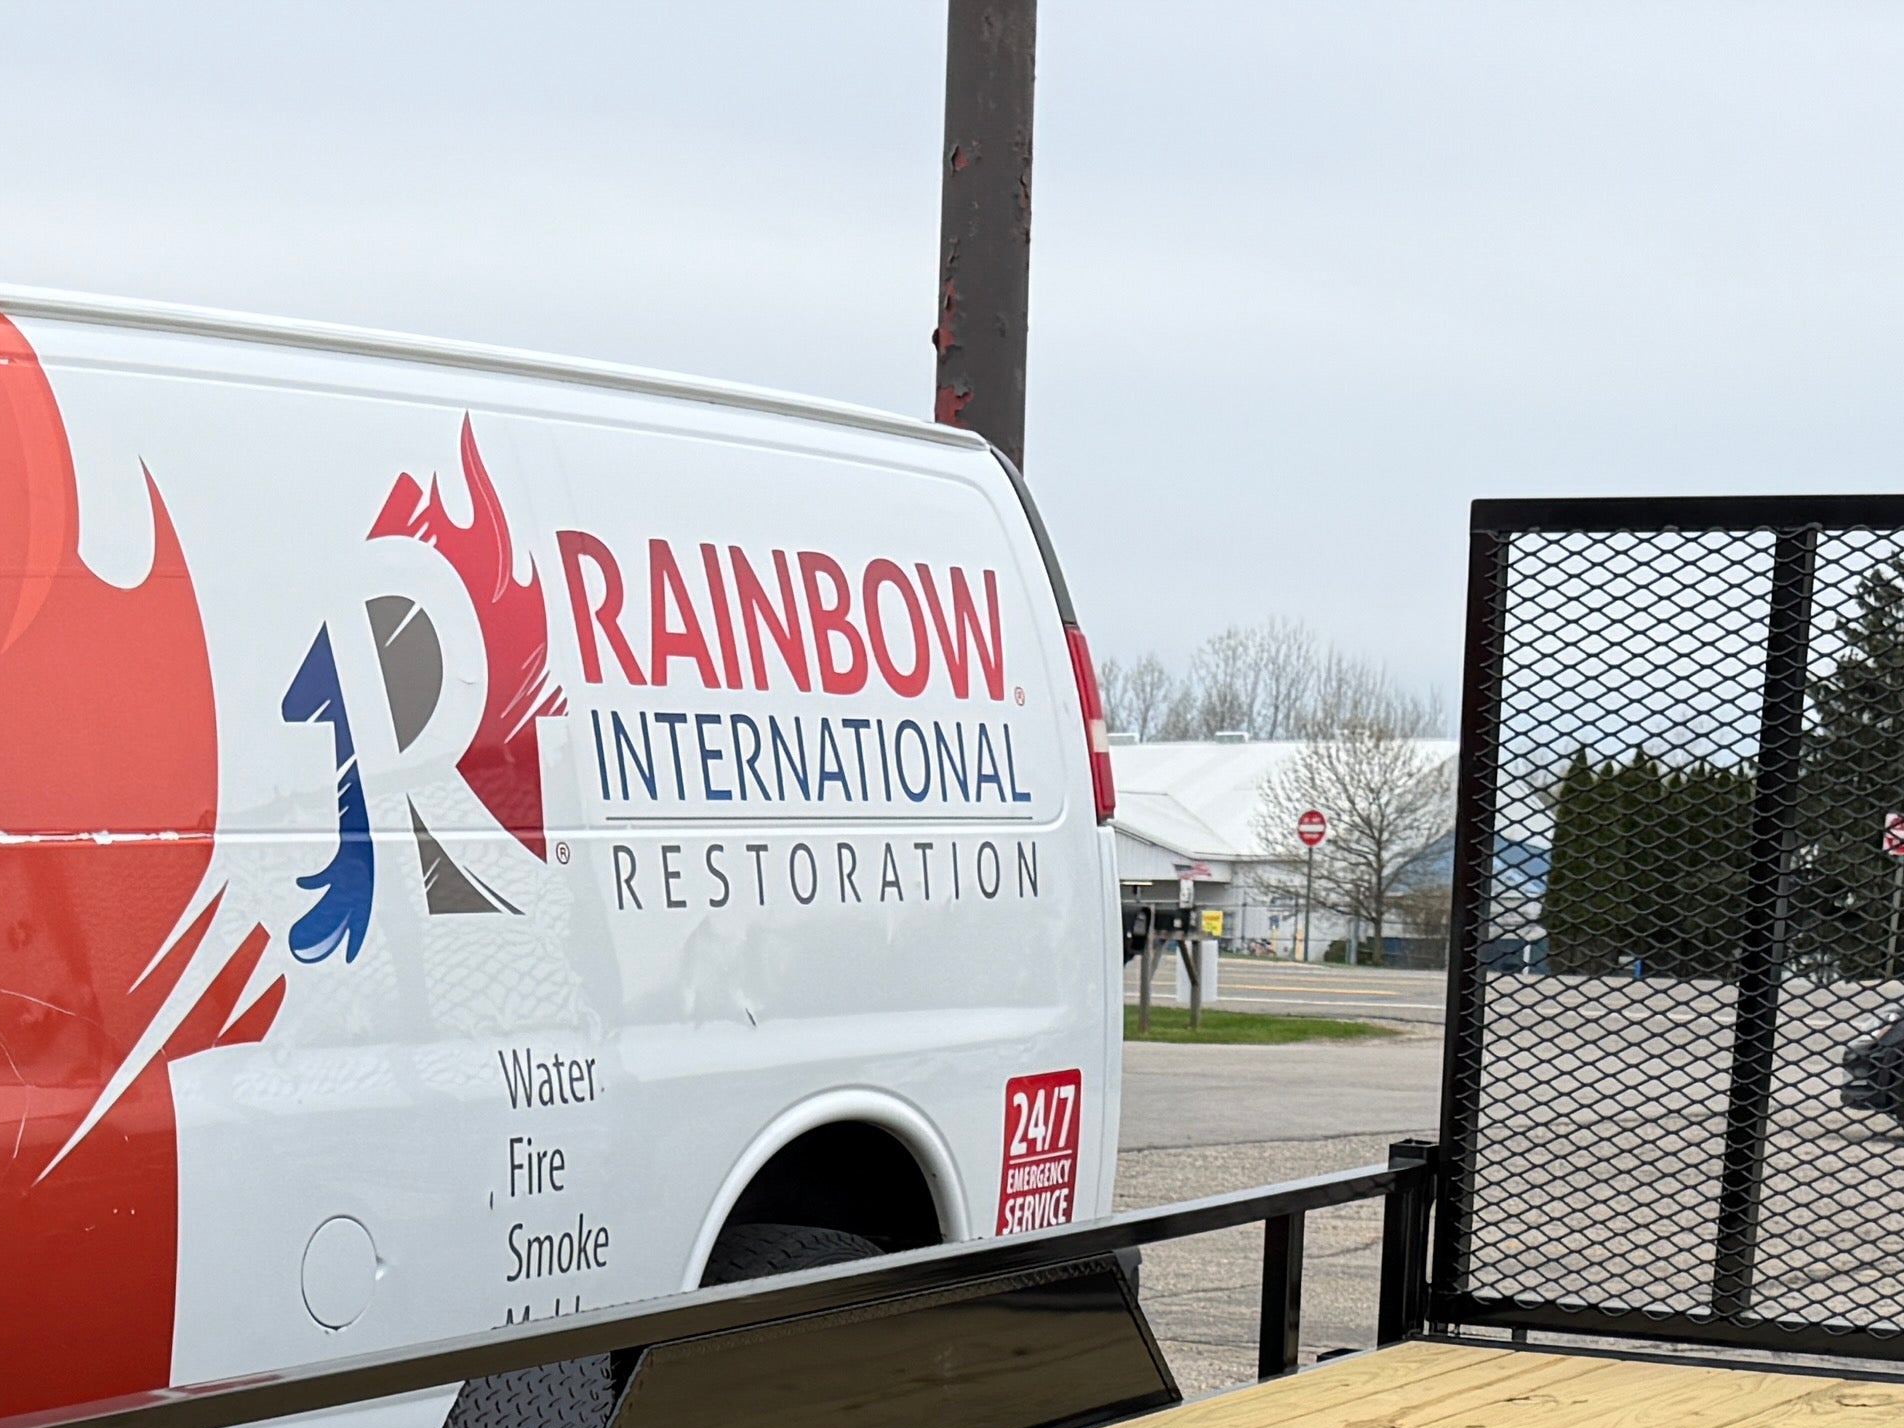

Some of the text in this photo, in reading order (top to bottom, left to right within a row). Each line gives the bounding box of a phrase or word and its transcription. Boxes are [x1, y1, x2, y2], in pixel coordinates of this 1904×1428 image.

[556, 529, 1004, 701] RAINBOW
[591, 709, 1032, 802] INTERNATIONAL
[612, 841, 1038, 910] RESTORATION
[498, 1048, 595, 1109] Water
[1010, 1085, 1075, 1156] 24/7
[510, 1137, 565, 1197] Fire
[1007, 1159, 1072, 1194] EMERGENCY
[1002, 1188, 1069, 1235] SERVICE
[506, 1213, 609, 1282] Smoke
